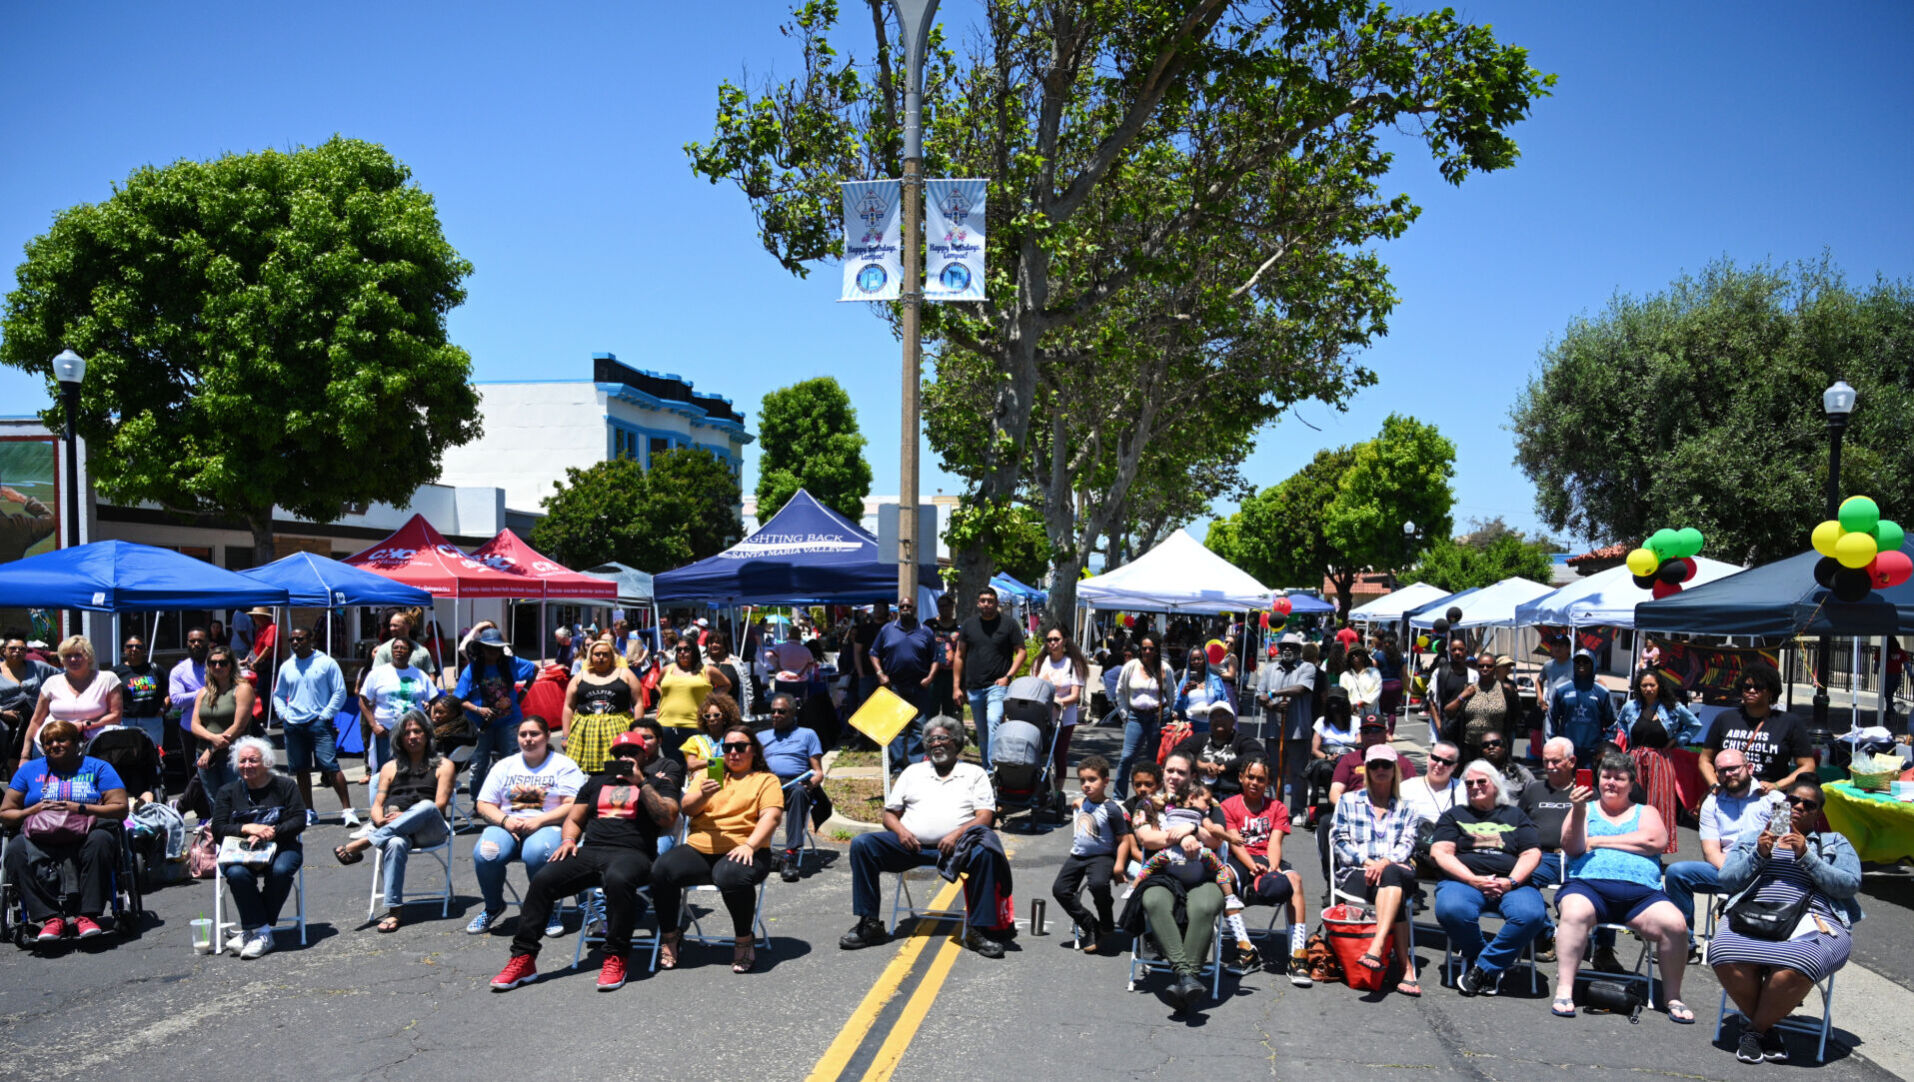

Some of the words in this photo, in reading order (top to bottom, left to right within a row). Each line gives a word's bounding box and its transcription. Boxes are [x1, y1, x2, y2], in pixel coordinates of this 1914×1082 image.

[847, 246, 866, 256] Happy
[929, 244, 950, 255] Happy
[806, 533, 843, 543] BACK
[731, 551, 766, 559] SANTA
[767, 548, 801, 557] MARIA
[1726, 728, 1770, 741] ABRAMS
[1722, 739, 1778, 755] CHISHOLM
[504, 774, 555, 787] INSPIRED
